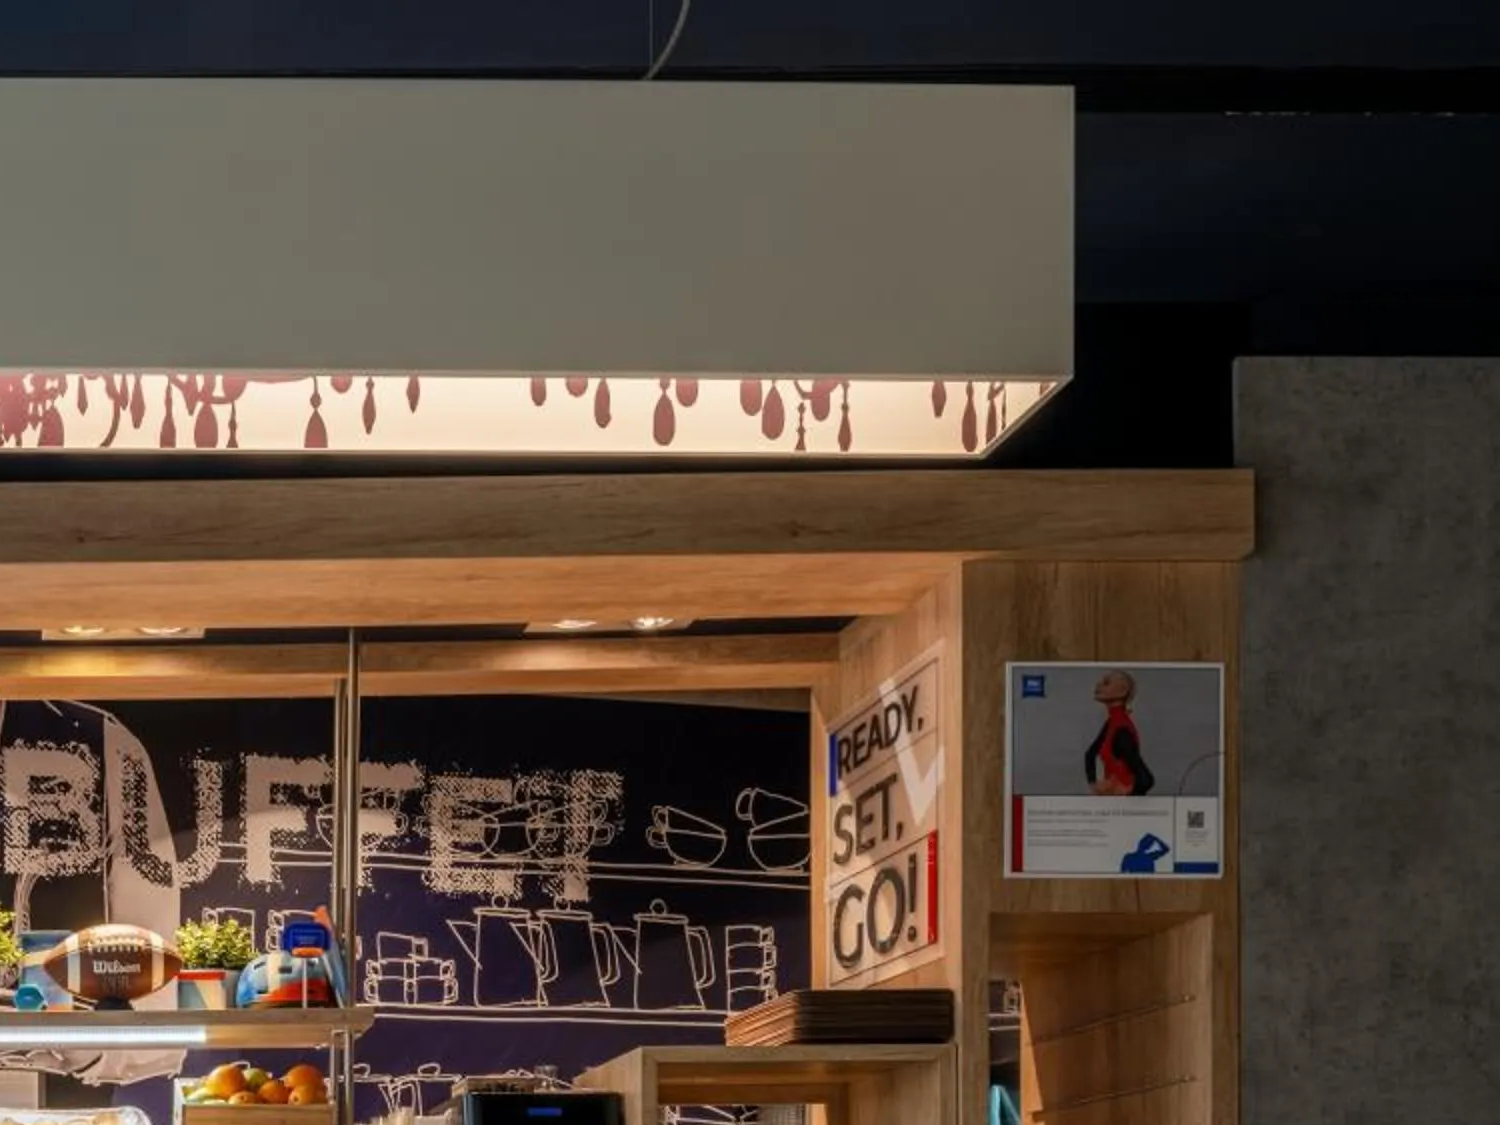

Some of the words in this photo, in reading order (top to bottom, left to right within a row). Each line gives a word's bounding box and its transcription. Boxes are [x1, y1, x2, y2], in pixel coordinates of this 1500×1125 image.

[836, 685, 924, 781] READY,
[832, 772, 904, 867] SET,
[832, 852, 918, 969] GO!
[92, 959, 141, 974] Wilson
